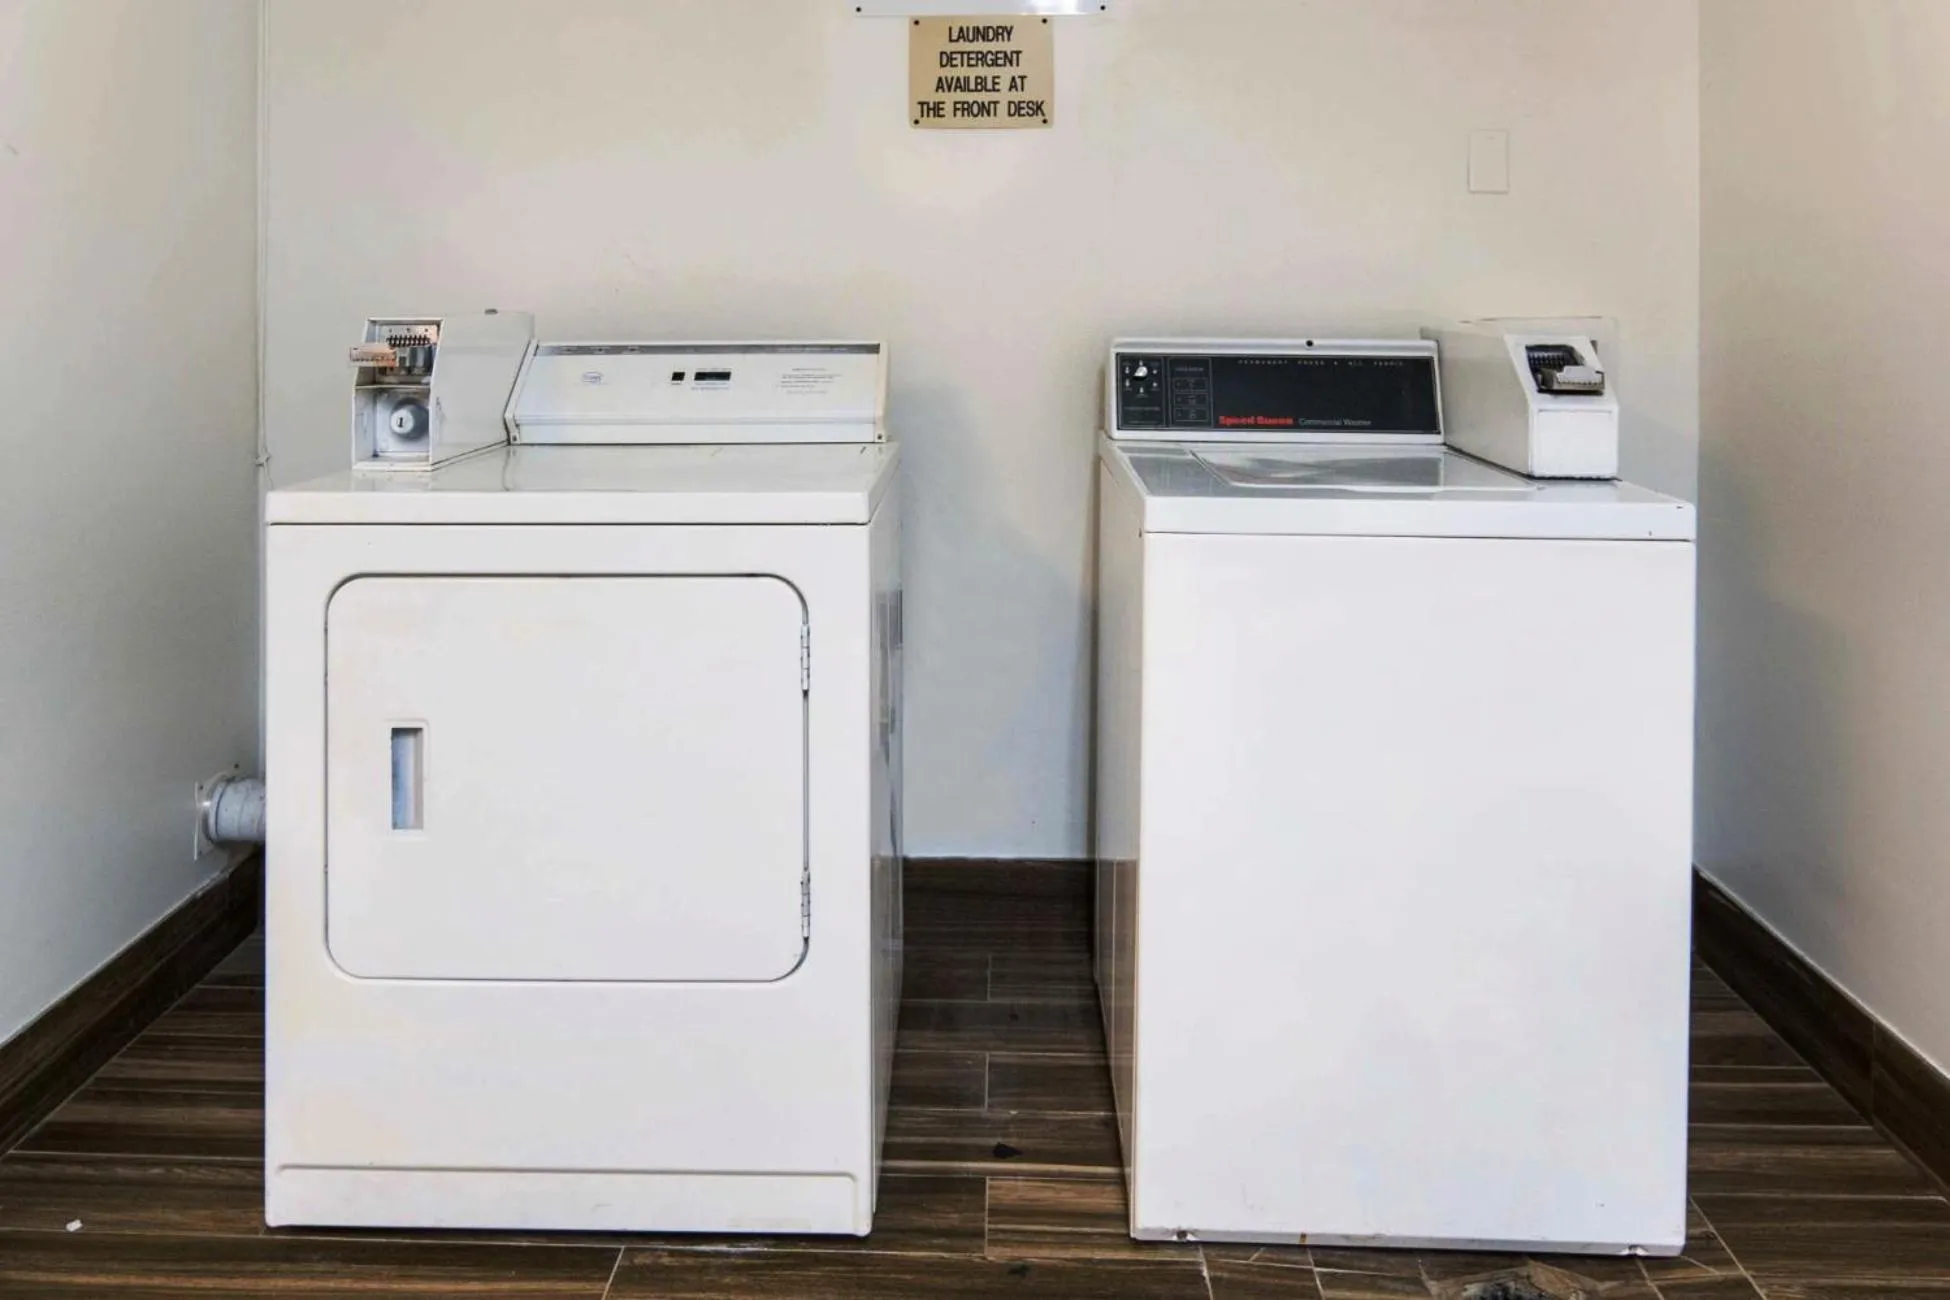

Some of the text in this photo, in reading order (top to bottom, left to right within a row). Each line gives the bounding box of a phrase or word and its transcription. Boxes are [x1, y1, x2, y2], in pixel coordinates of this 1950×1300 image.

[949, 26, 1014, 42] LAUNDRY
[940, 51, 1022, 67] DETERGENT
[936, 75, 1027, 92] AVAILBLE AT
[918, 100, 1046, 118] THE FRONT DESK
